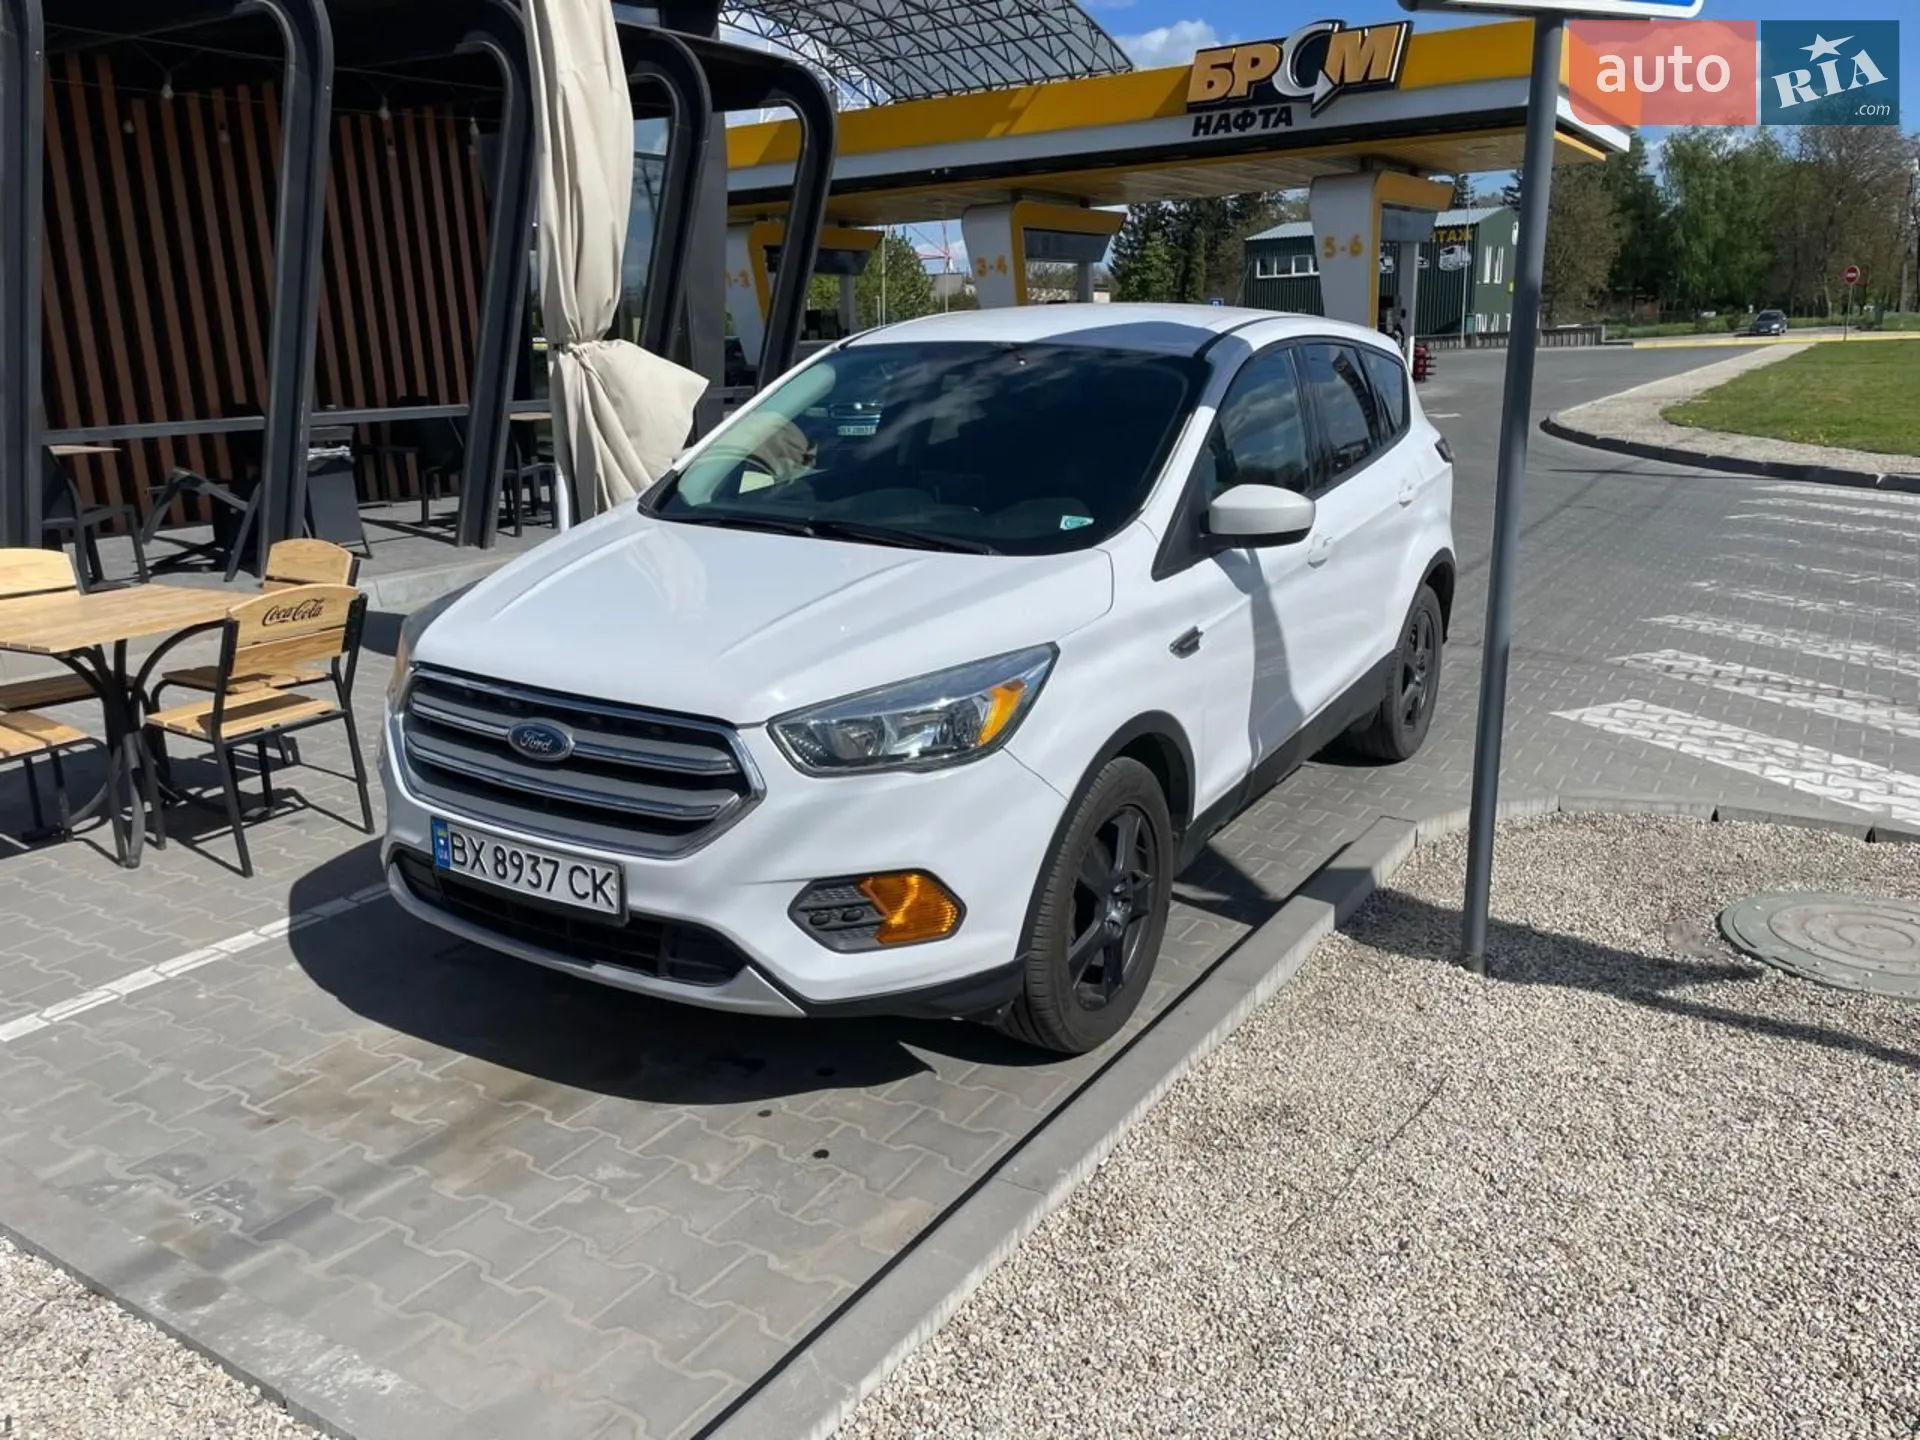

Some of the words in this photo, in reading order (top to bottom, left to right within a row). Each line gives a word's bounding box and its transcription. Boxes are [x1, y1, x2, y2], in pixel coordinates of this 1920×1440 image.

[1187, 20, 1407, 103] БРСМ
[1192, 106, 1293, 137] НАФТА
[1323, 233, 1364, 259] 5-6
[520, 730, 553, 752] Ford
[451, 832, 489, 877] BX
[493, 845, 560, 893] 8937
[568, 865, 615, 908] CK
